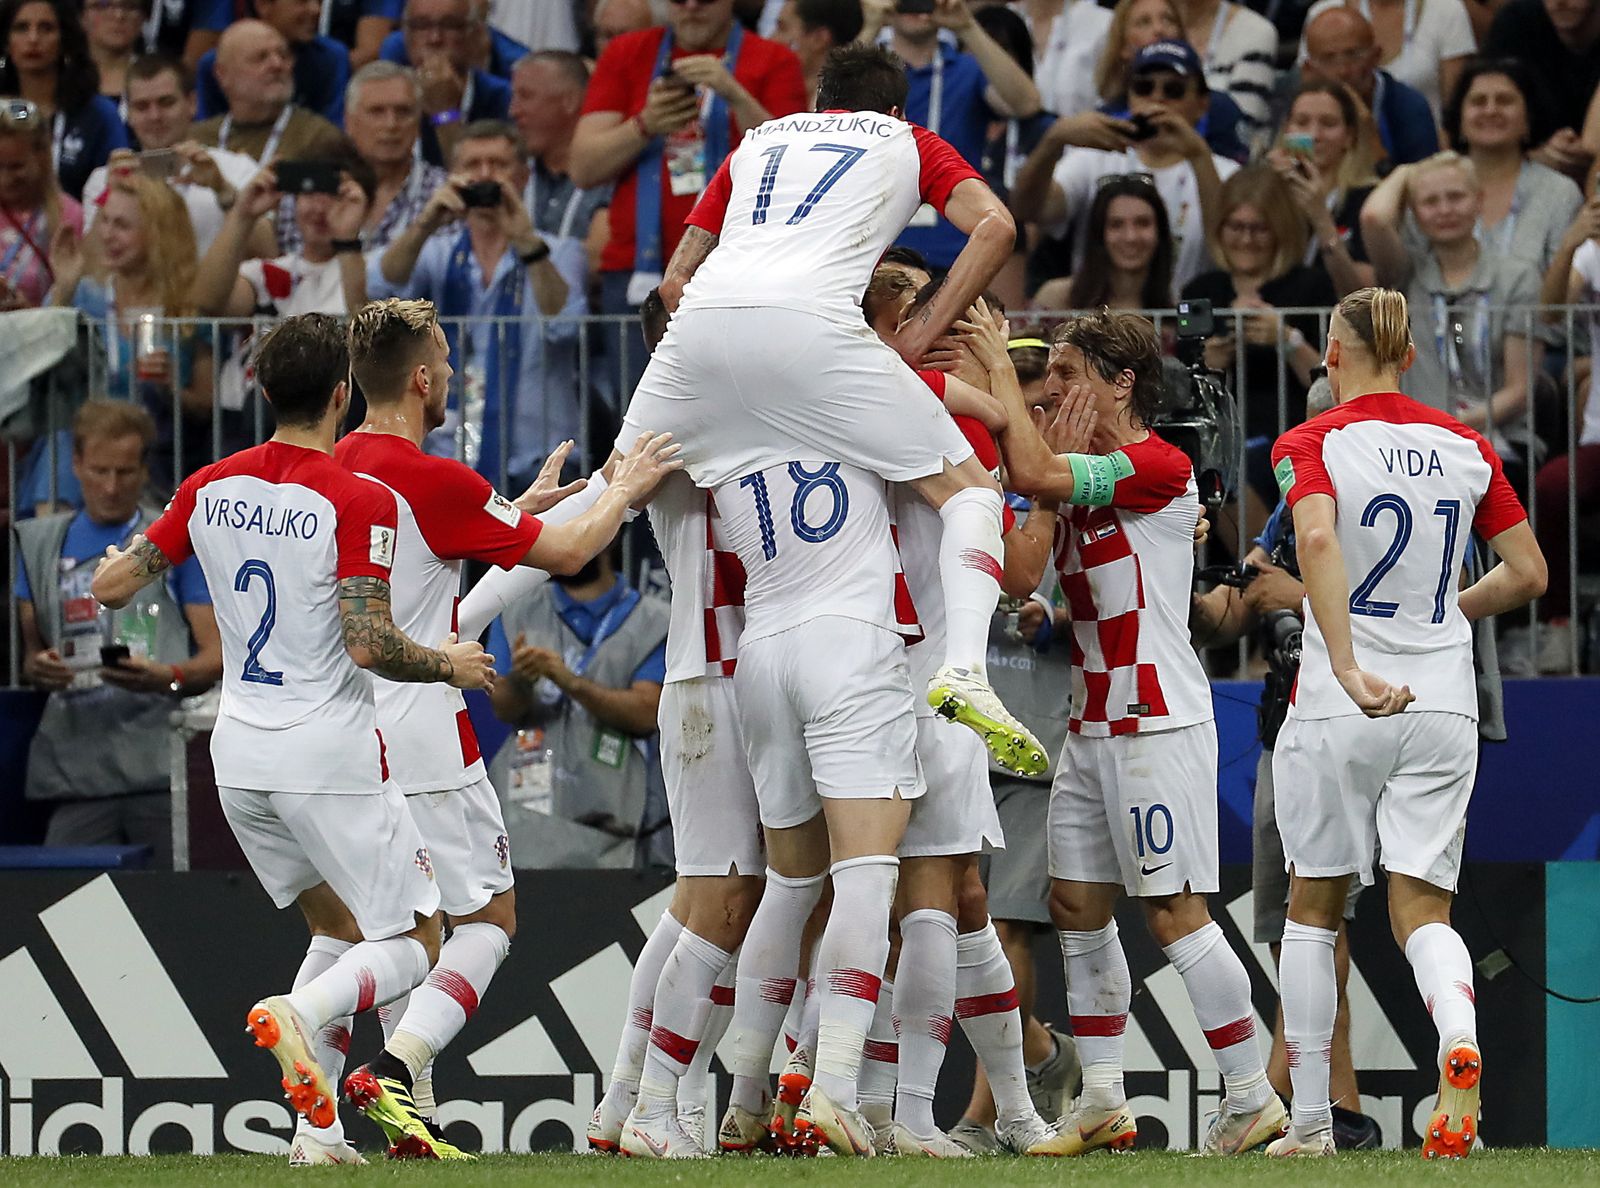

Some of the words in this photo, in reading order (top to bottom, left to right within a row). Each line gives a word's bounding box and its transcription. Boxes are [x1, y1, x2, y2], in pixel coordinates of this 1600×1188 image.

[752, 143, 868, 226] 17
[1092, 463, 1103, 500] OTBALL
[1097, 461, 1109, 500] IVING
[1378, 447, 1444, 478] VIDA
[739, 460, 849, 562] 18
[1080, 481, 1090, 500] FIFA
[205, 497, 318, 540] VRSALJKO
[1348, 493, 1461, 624] 21
[233, 559, 285, 686] 2
[1129, 803, 1174, 858] 10
[0, 1076, 293, 1155] idas
